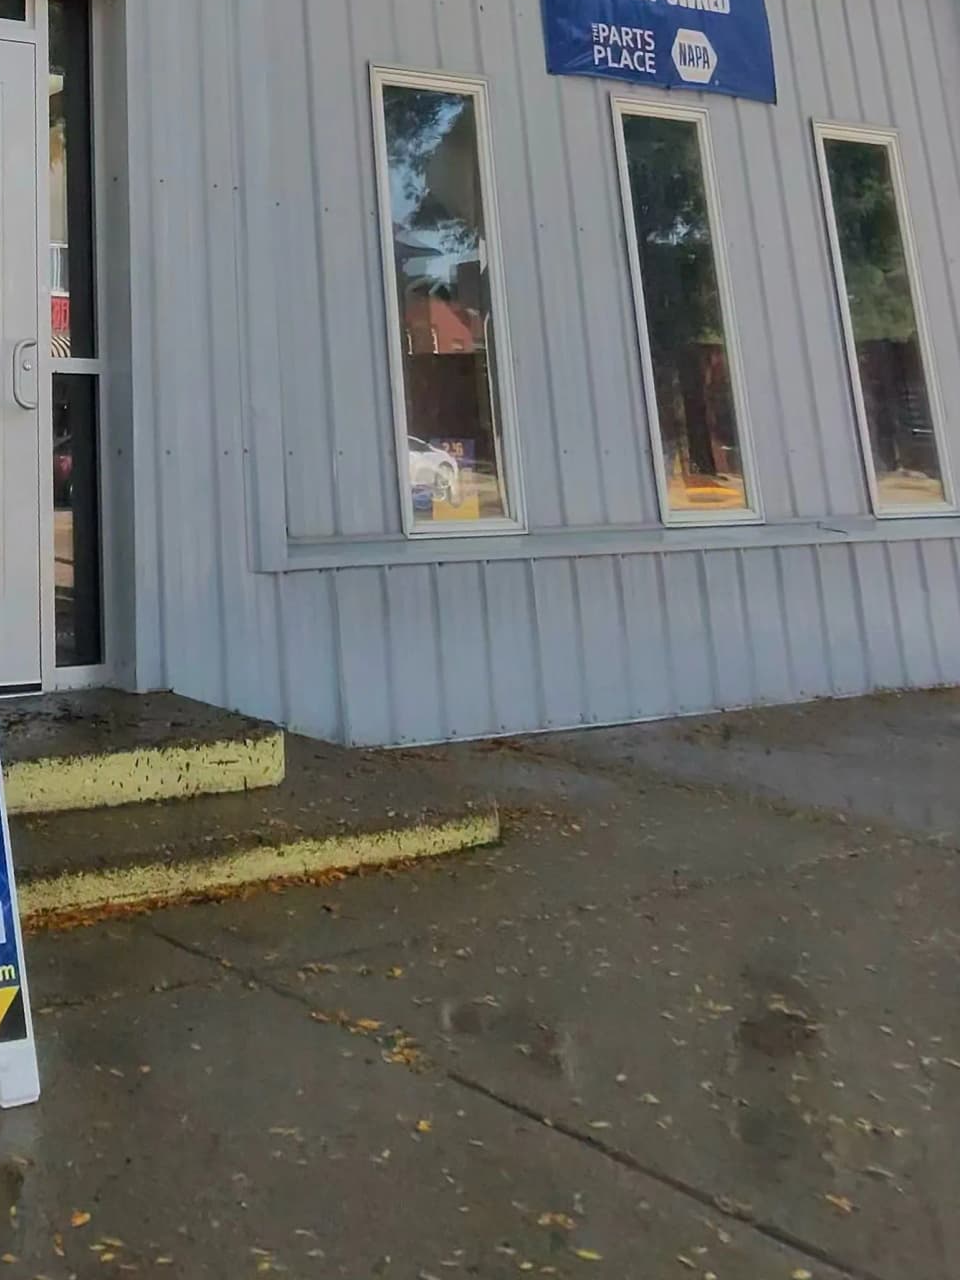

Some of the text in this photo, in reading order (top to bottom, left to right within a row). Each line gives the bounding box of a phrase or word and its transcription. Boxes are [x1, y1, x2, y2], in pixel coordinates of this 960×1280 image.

[598, 23, 655, 51] PARTS
[593, 44, 657, 74] PLACE
[678, 41, 711, 70] NAPA
